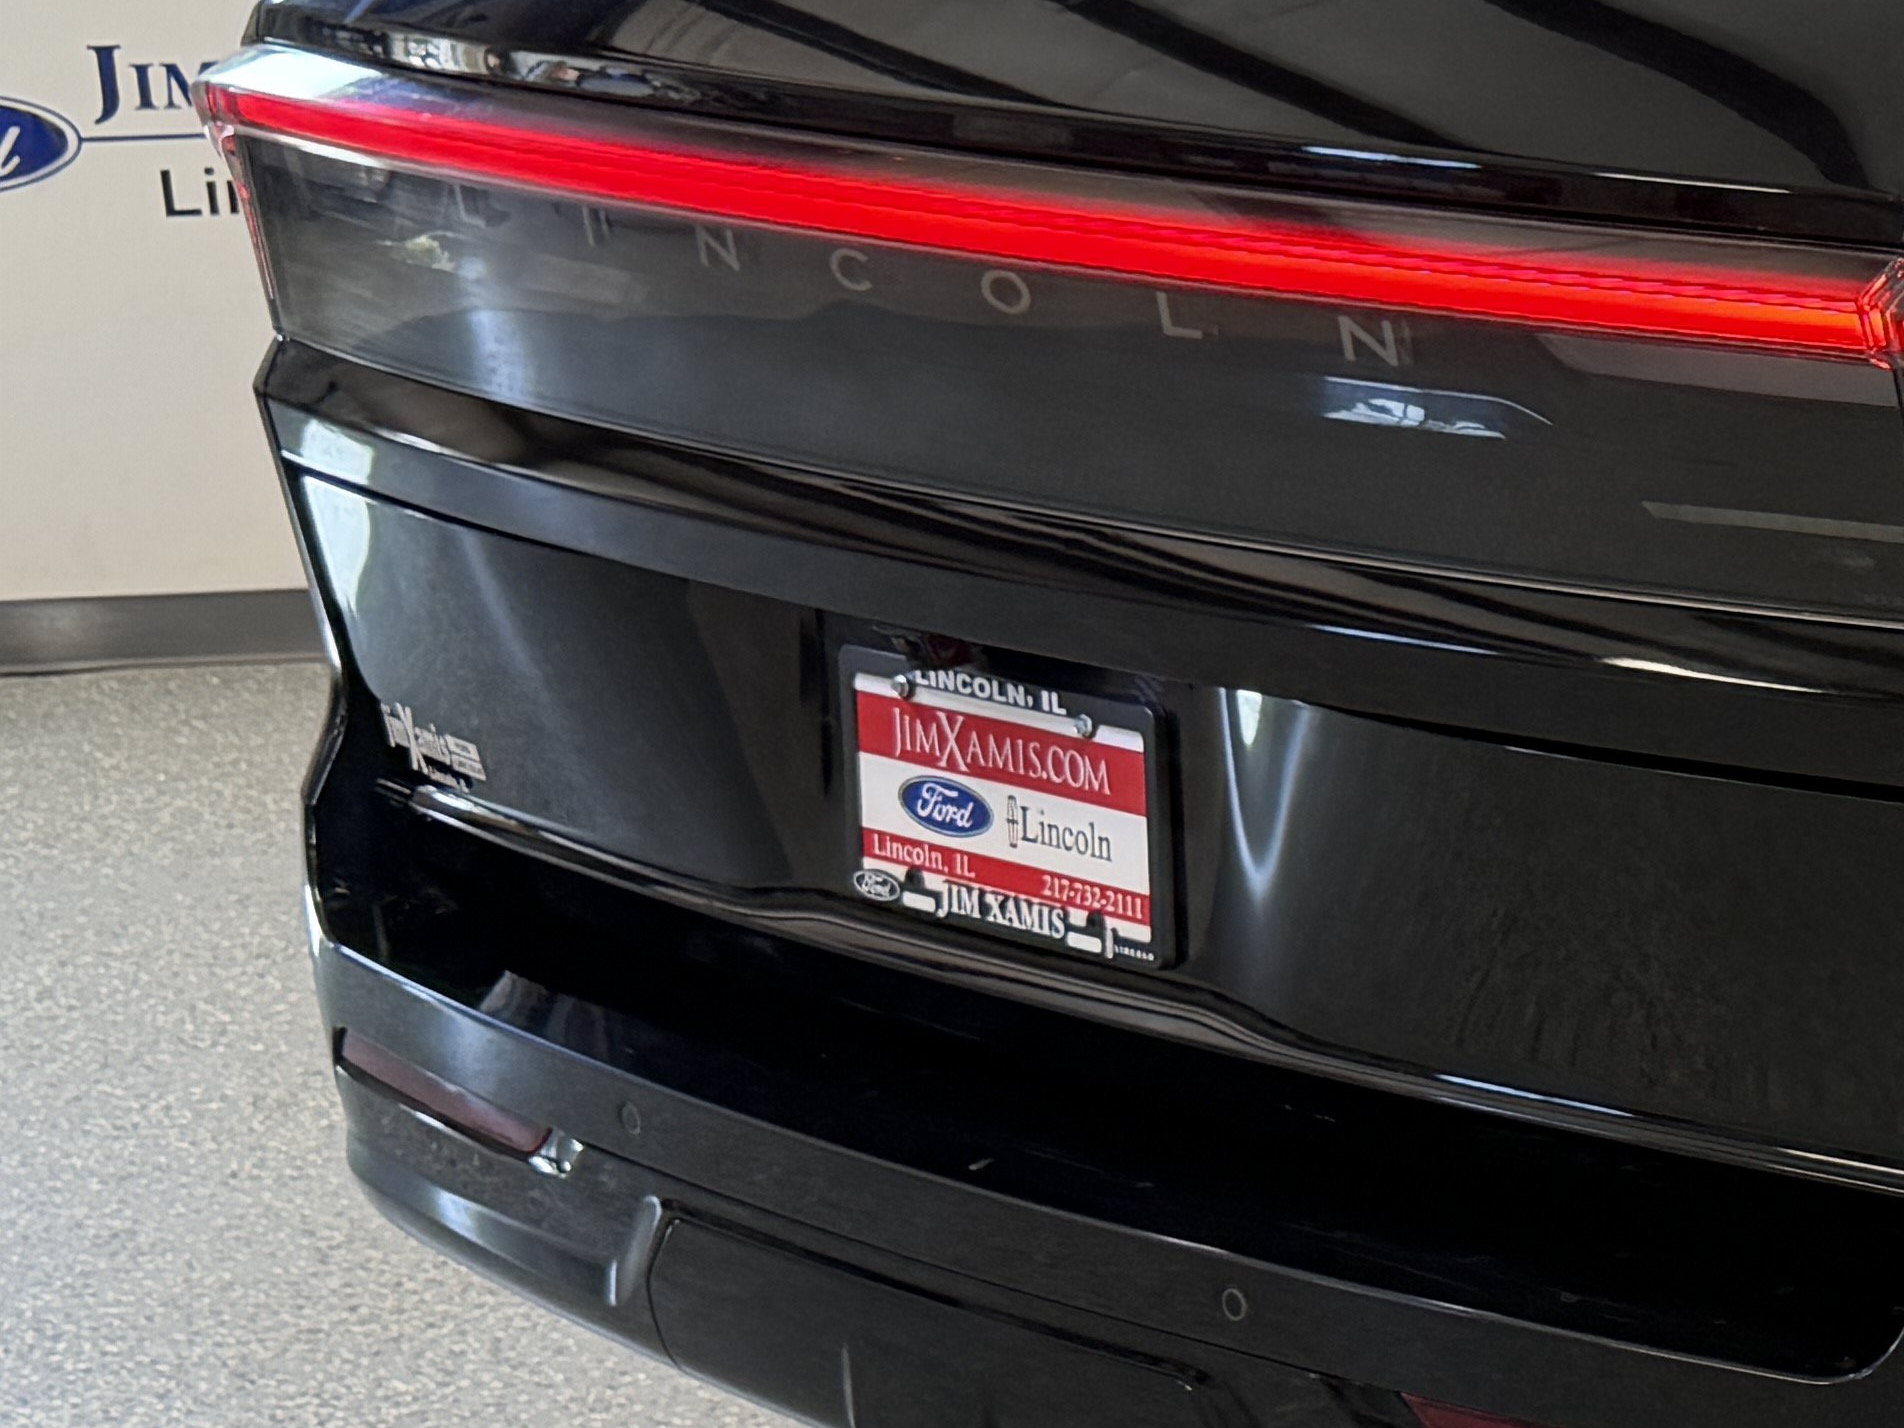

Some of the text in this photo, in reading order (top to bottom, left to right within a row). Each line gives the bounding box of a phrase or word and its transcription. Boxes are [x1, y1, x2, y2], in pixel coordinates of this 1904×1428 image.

[452, 182, 1402, 368] LINCOLN
[1041, 690, 1067, 715] IL
[892, 706, 1111, 796] JIMXAMIS.COM
[916, 782, 974, 830] Ford
[1020, 805, 1112, 862] Lincoln
[954, 854, 976, 878] IL
[936, 881, 1066, 939] JIM XAMIS
[1041, 873, 1143, 919] 217-732-2111
